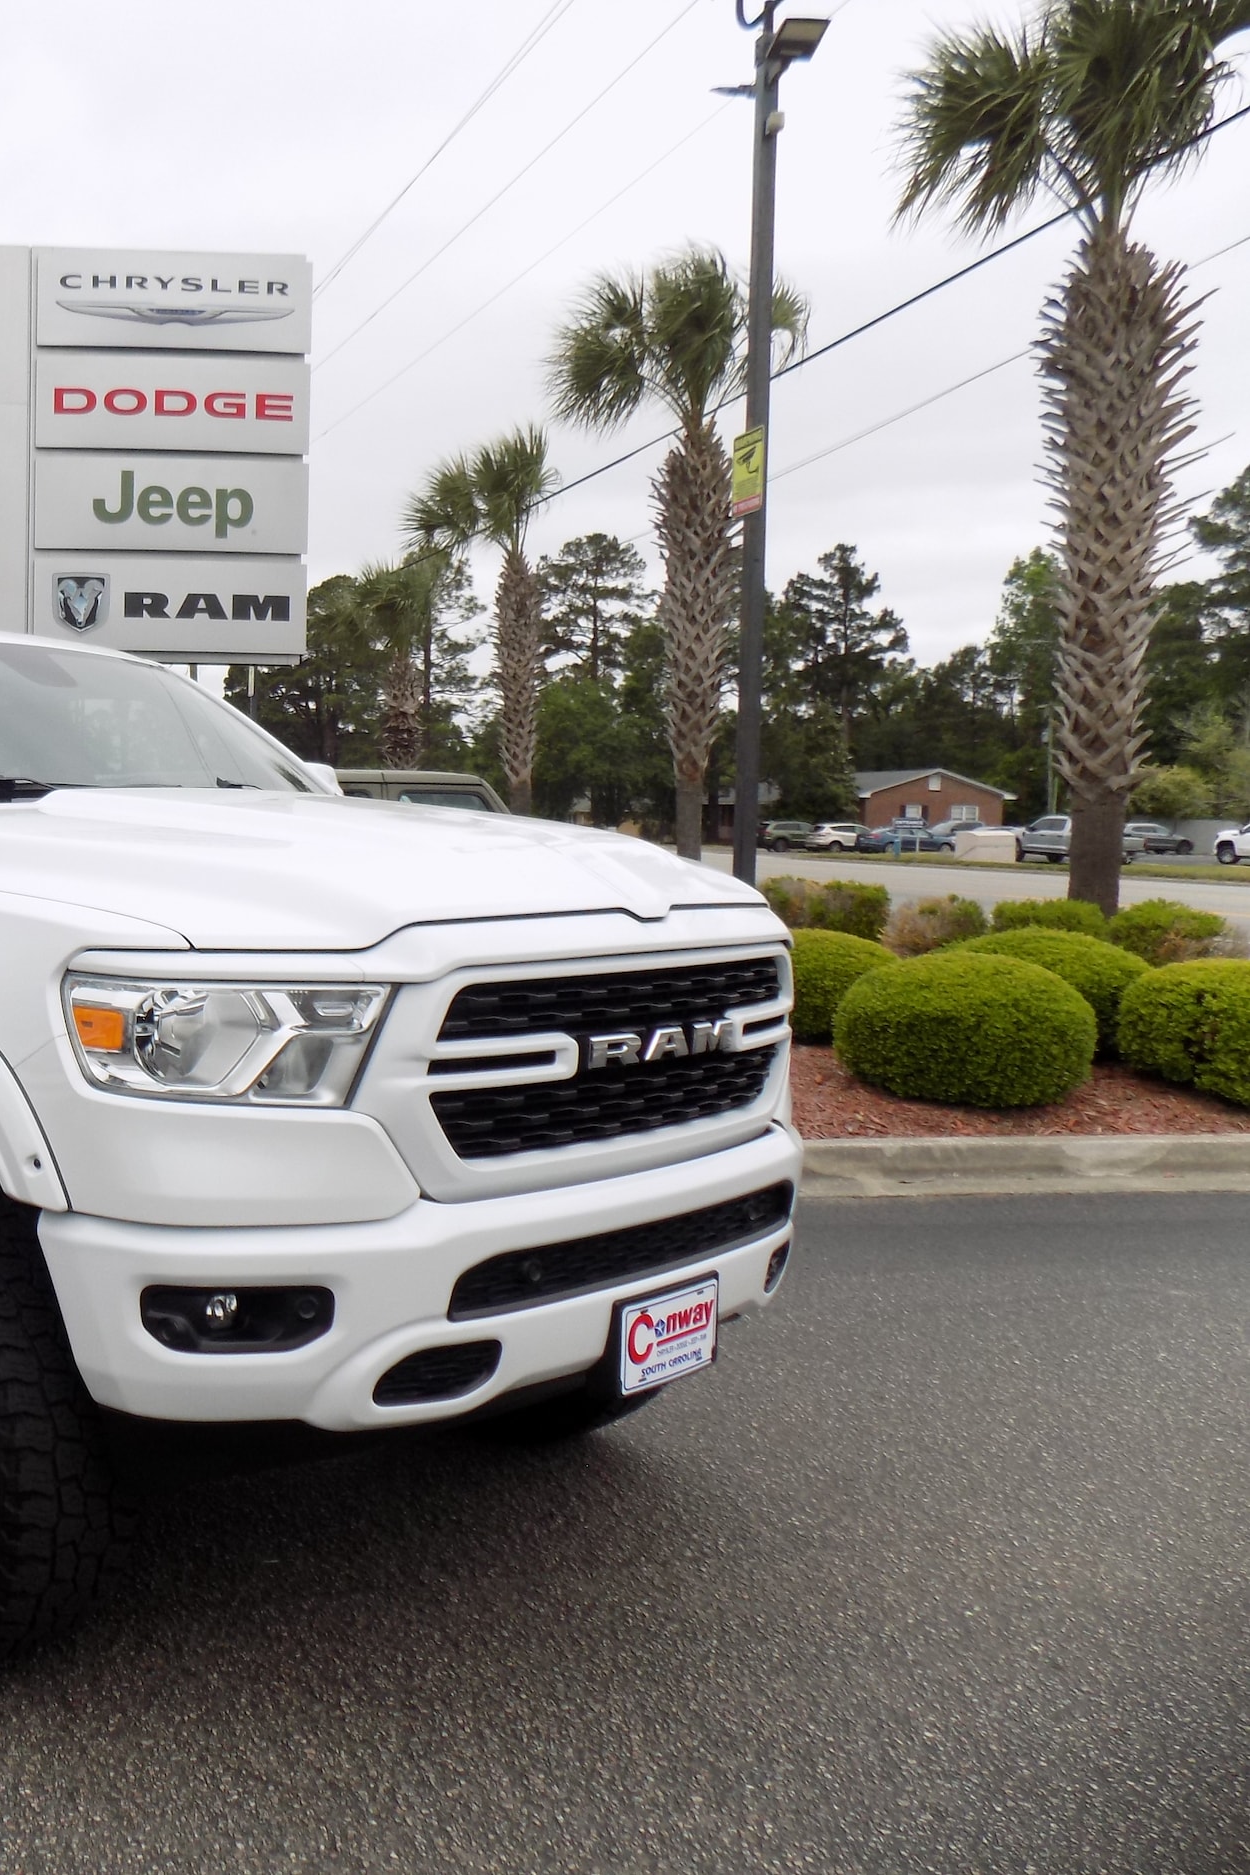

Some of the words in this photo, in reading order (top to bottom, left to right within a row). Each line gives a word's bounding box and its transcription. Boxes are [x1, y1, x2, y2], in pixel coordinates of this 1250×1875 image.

[59, 274, 290, 296] CHRYSLER
[53, 387, 294, 421] DODGE
[92, 470, 254, 539] Jeep
[123, 591, 291, 621] RAM
[588, 1019, 734, 1069] RAM
[641, 1360, 667, 1377] SOUTH
[668, 1347, 703, 1368] CAROLINA
